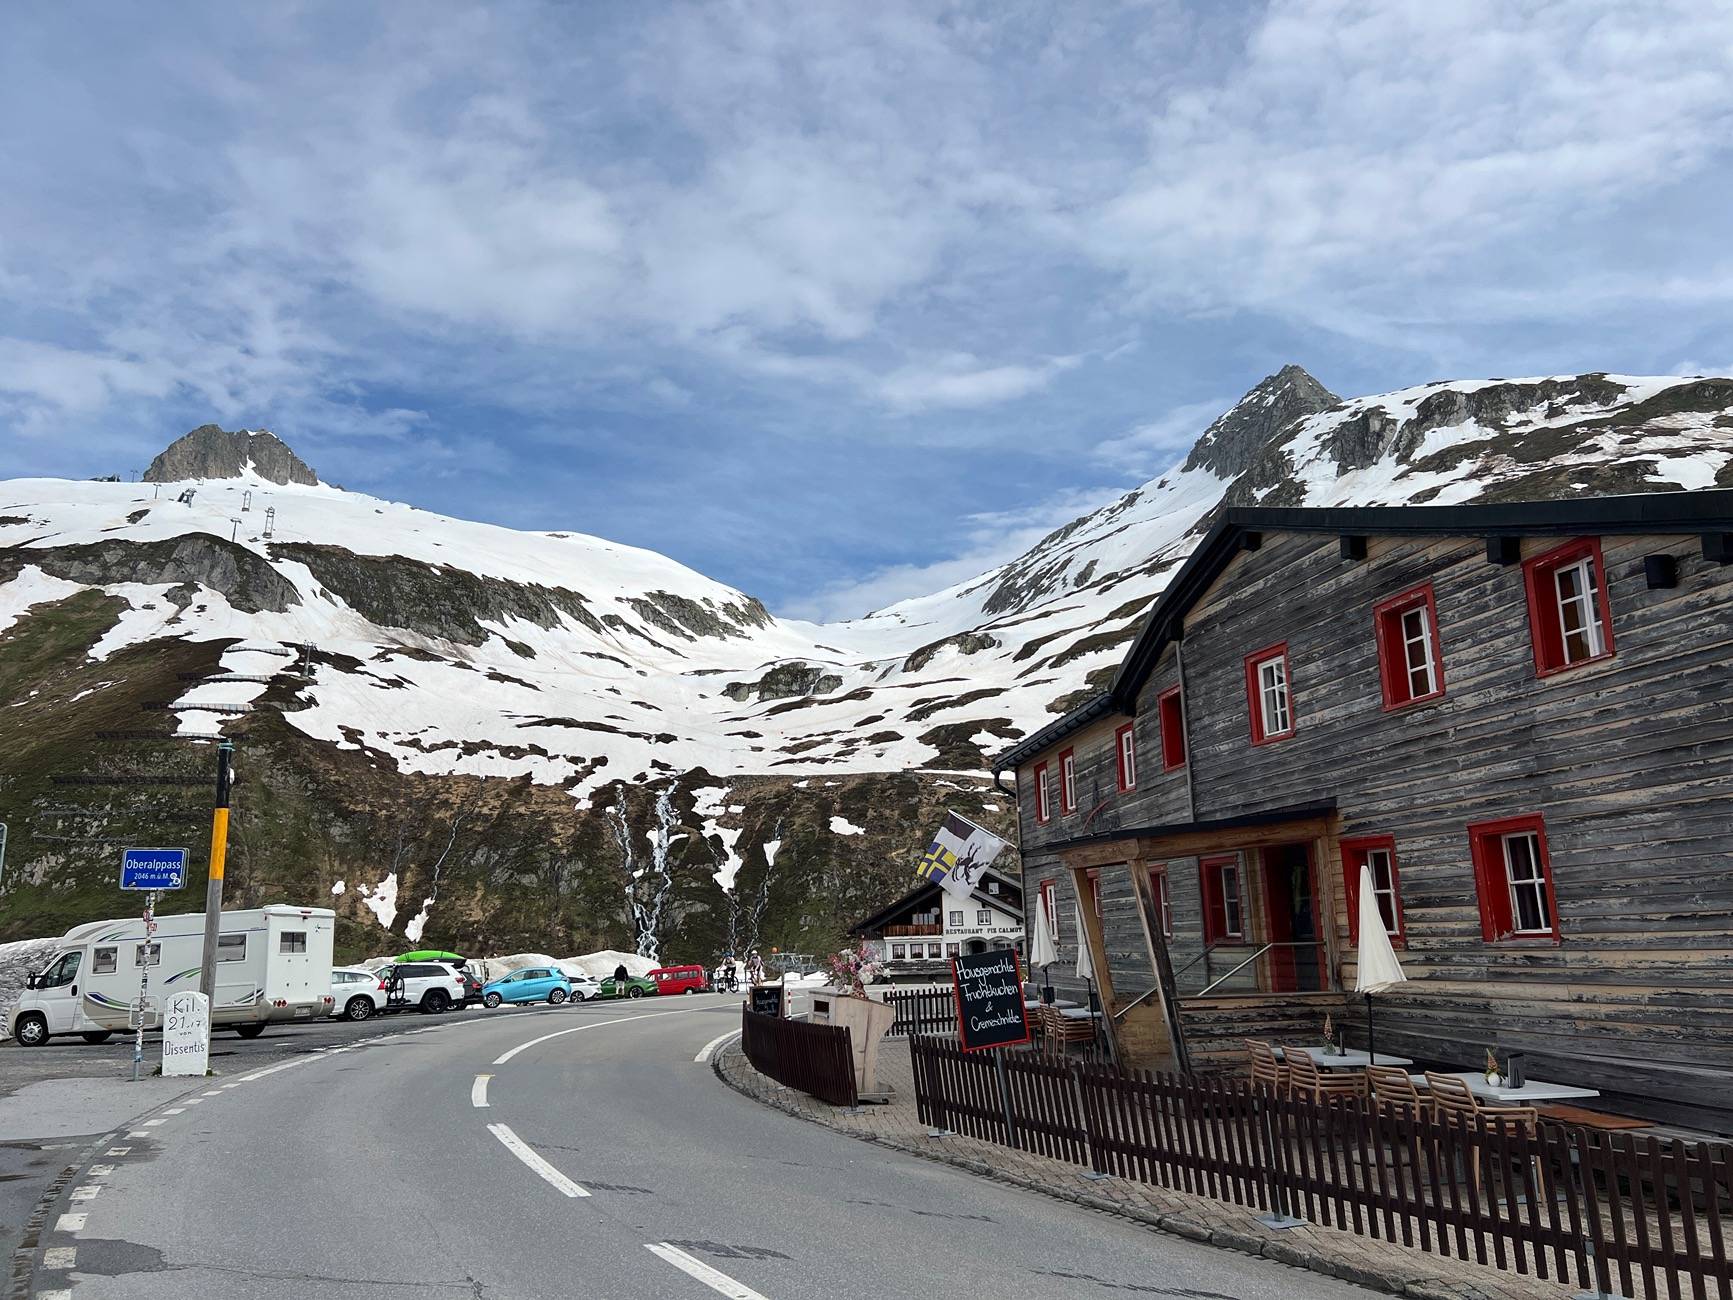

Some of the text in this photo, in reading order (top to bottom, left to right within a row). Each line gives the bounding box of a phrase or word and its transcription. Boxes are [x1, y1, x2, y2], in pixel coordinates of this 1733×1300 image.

[126, 859, 181, 871] Oberalppass
[955, 957, 1016, 985] Hausgemachte
[960, 979, 1018, 1002] Fruchtkuchen
[173, 998, 200, 1014] Kil.
[985, 1001, 993, 1013] &
[970, 1009, 1021, 1031] Cremeschnitte
[164, 1041, 205, 1056] Dissentis
